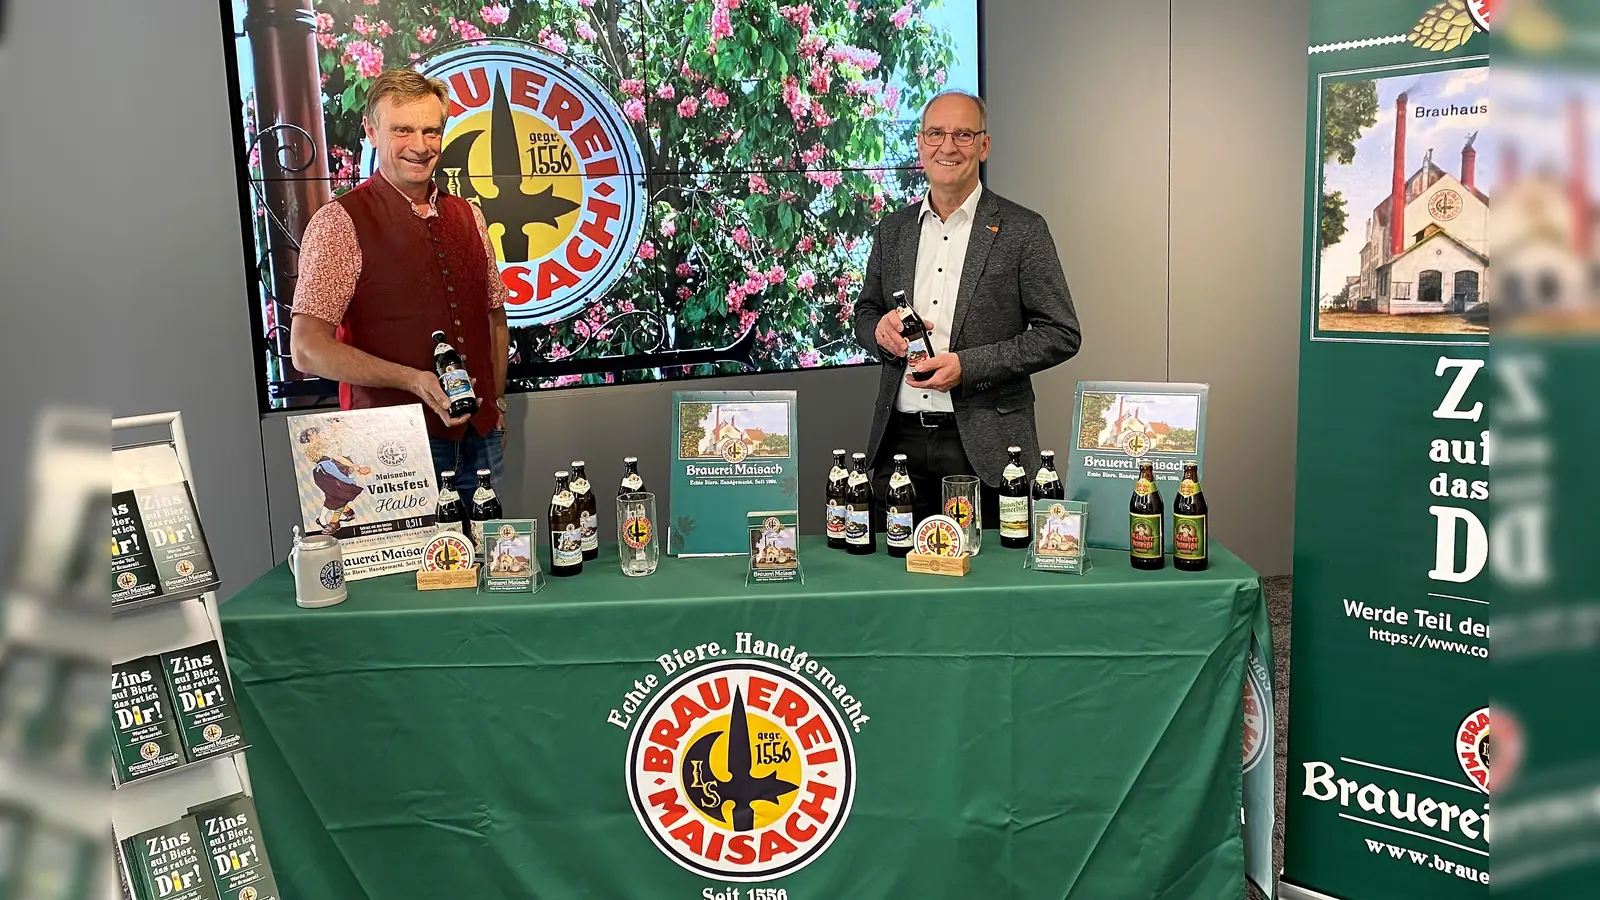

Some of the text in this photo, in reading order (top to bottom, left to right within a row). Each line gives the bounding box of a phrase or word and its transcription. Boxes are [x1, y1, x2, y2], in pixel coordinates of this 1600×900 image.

[1415, 104, 1488, 118] Brauhaus
[529, 131, 560, 145] gegr.
[526, 143, 572, 179] 1556
[501, 197, 621, 305] SACH
[686, 463, 783, 475] Brauerei Maisach
[1084, 456, 1133, 468] Brauerei
[375, 470, 417, 480] Maisacher
[367, 478, 429, 495] Volksfest
[1429, 473, 1489, 500] das
[141, 494, 182, 510] Zins
[375, 494, 428, 513] Halbe
[145, 506, 188, 520] auf Bier,
[344, 551, 380, 567] auerei
[1343, 598, 1408, 625] Werde
[1414, 609, 1453, 632] Teil
[170, 654, 213, 674] Zins
[112, 670, 152, 690] Zins
[174, 667, 218, 684] auf Bier,
[177, 675, 220, 692] das rat ich
[607, 632, 871, 733] Echte Biere. Handgemacht.
[112, 683, 157, 700] auf Bier,
[113, 700, 129, 709] das
[145, 692, 158, 700] ich
[755, 741, 792, 766] 1556
[1302, 761, 1489, 844] Brauerei
[205, 813, 247, 837] Zins
[648, 780, 838, 865] MAISACH
[146, 831, 191, 856] Zins
[209, 828, 253, 847] auf Bier,
[212, 836, 254, 855] das rat ich
[150, 846, 196, 867] auf Bier,
[152, 855, 198, 876] das rat ich
